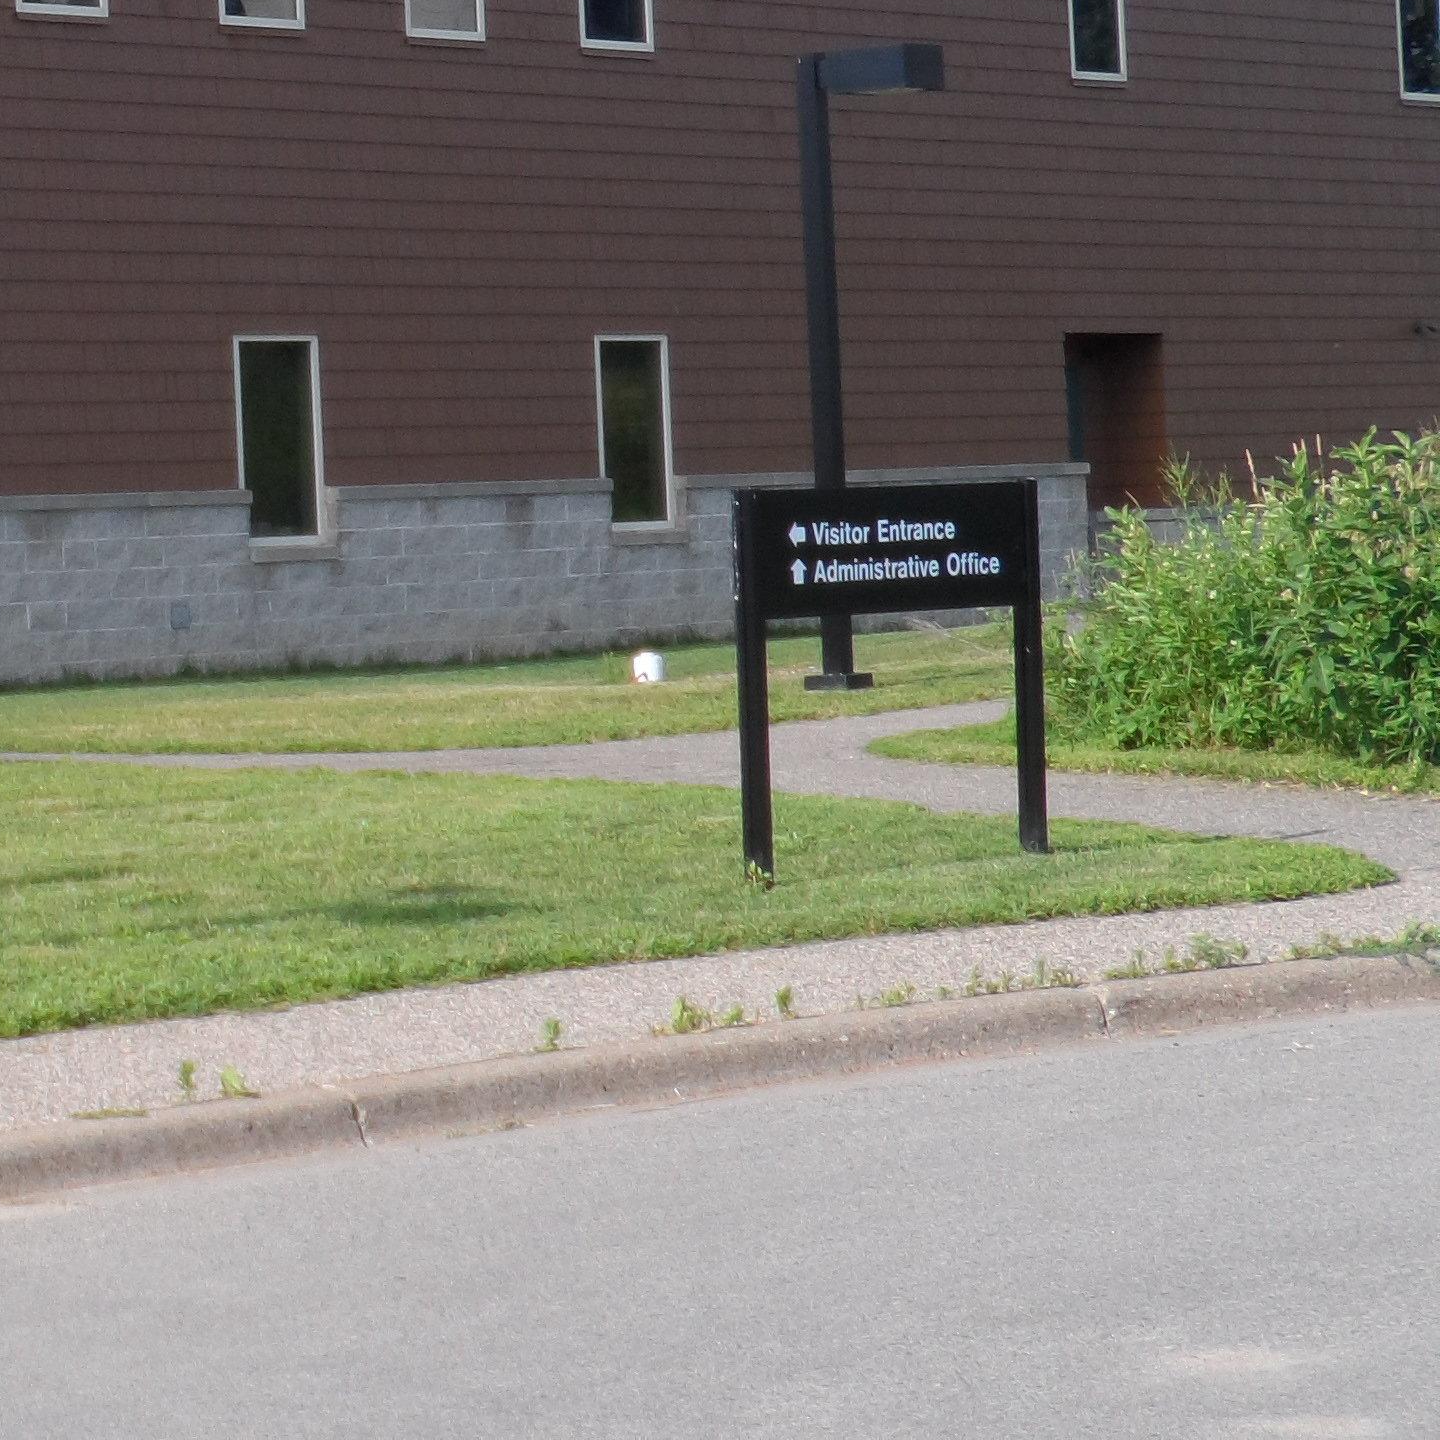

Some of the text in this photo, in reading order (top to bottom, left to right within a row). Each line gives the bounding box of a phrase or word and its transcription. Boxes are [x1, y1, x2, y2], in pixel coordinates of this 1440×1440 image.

[811, 518, 957, 546] Visitor Entrance
[813, 551, 1002, 584] Administrative Office
